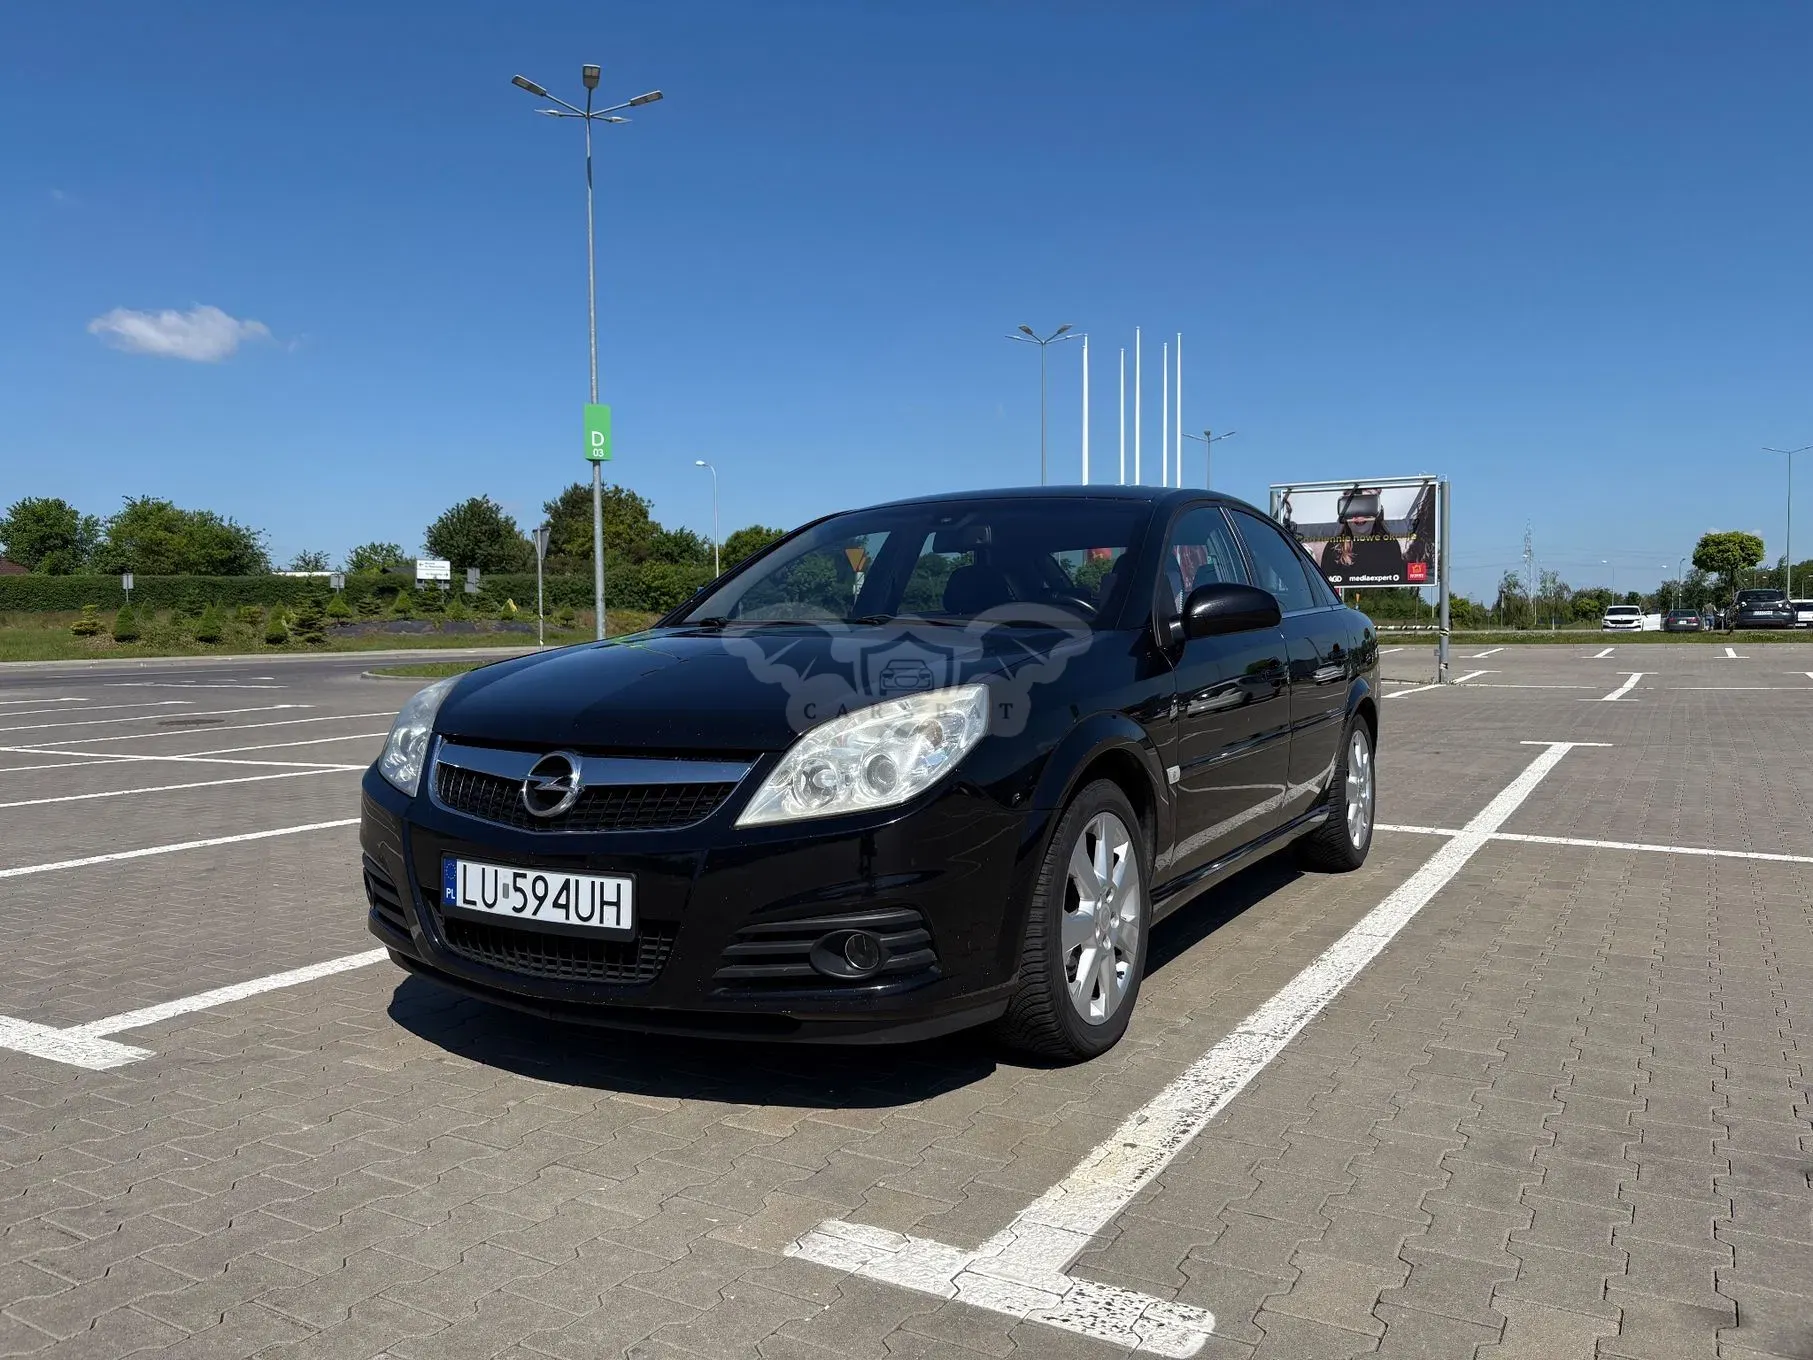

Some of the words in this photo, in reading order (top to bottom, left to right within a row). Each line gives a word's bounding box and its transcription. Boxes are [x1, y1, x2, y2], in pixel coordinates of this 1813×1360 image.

[591, 430, 605, 447] D
[592, 448, 605, 457] 03
[1353, 532, 1381, 542] nowe
[1349, 575, 1393, 583] mediaexpert
[445, 887, 456, 900] PL
